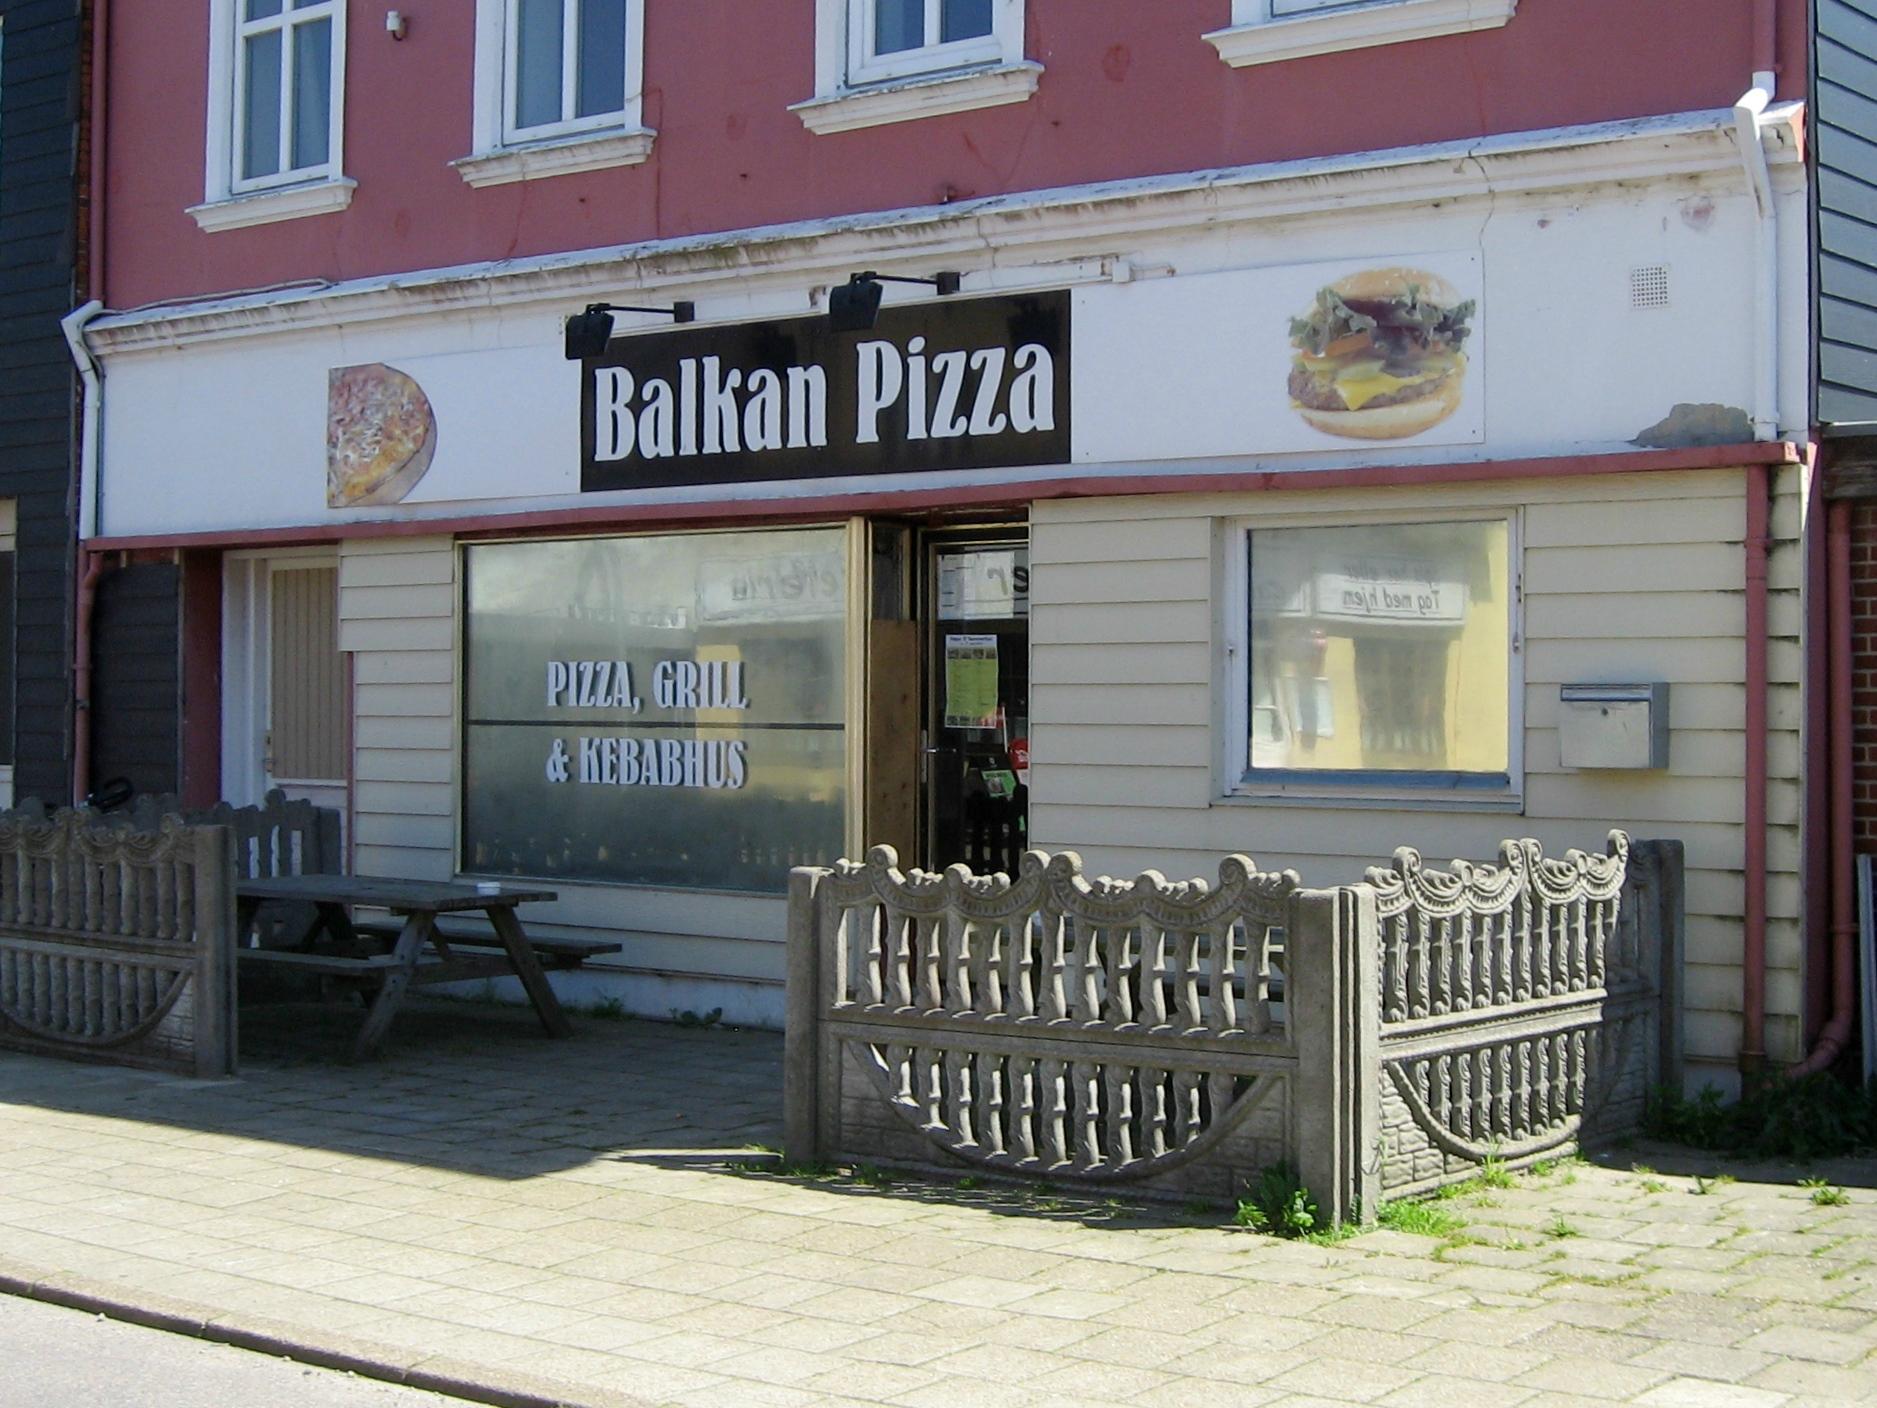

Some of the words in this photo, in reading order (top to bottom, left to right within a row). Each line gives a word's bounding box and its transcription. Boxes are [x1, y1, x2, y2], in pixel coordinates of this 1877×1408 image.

[594, 354, 828, 462] Balkan
[855, 335, 1055, 444] Pizza
[547, 660, 641, 715] PIZZA,
[652, 660, 749, 710] GRILL
[545, 738, 571, 783] &
[579, 737, 747, 790] KEBABHUS
